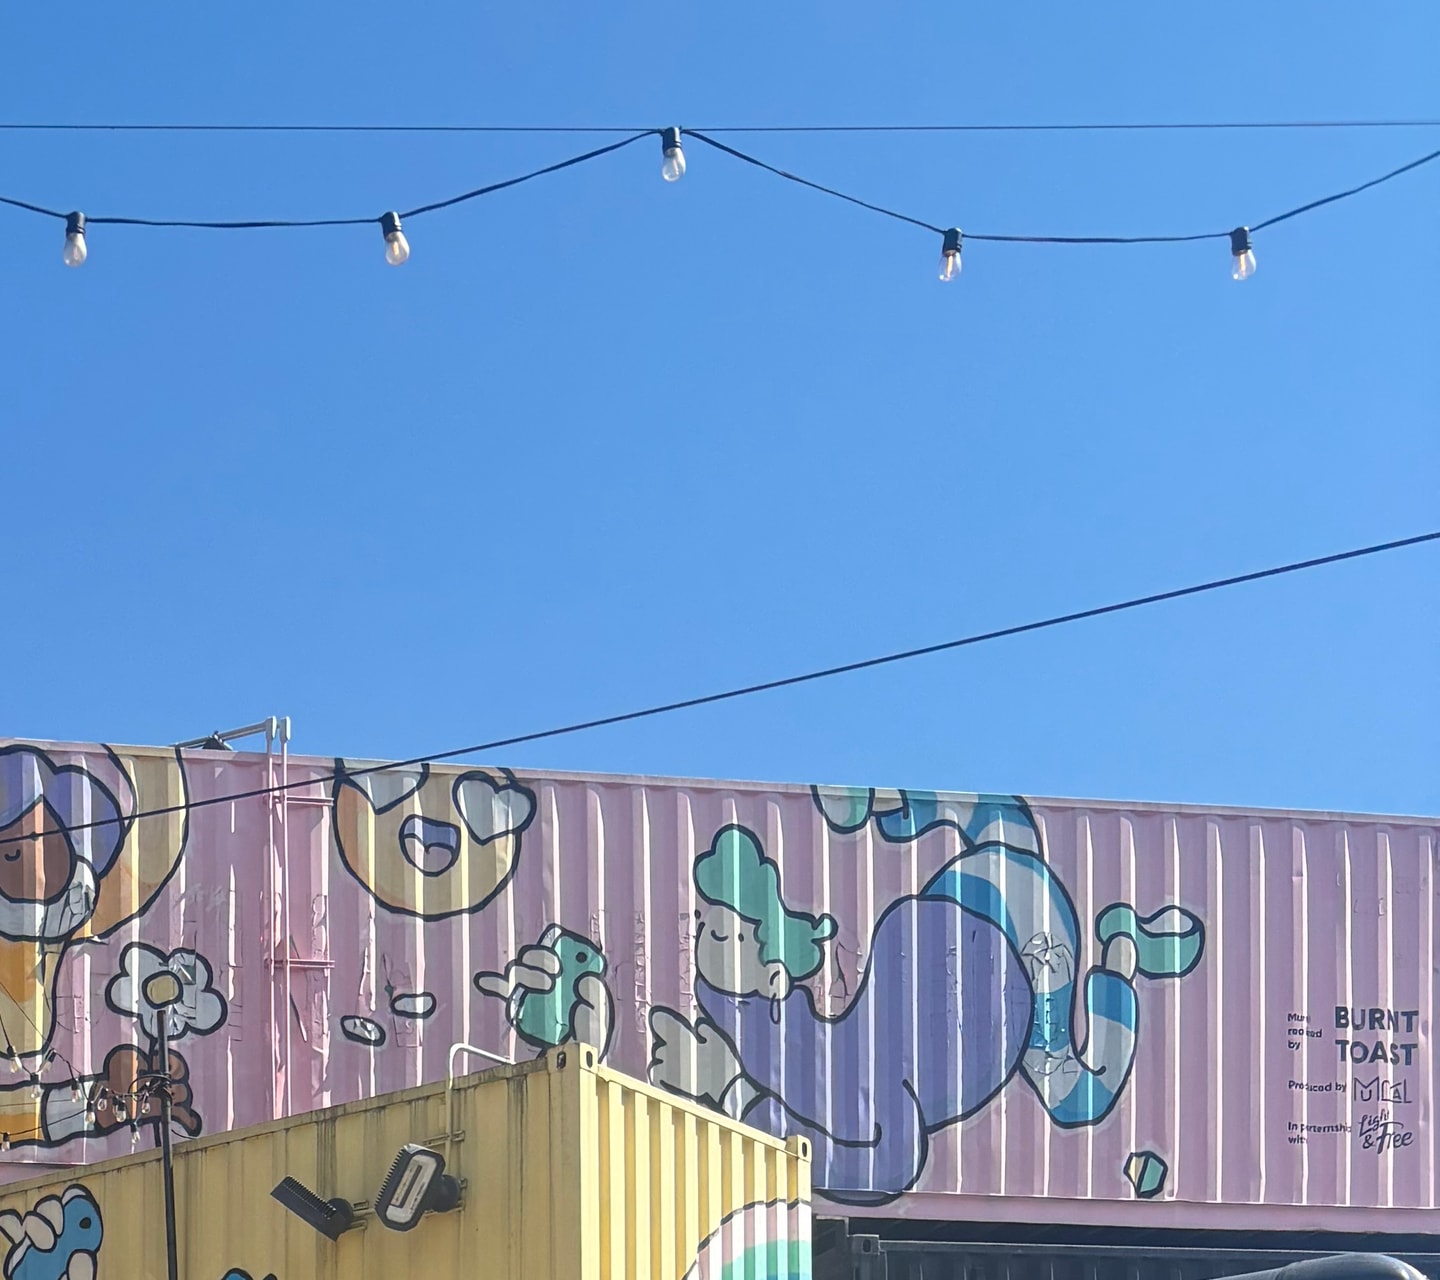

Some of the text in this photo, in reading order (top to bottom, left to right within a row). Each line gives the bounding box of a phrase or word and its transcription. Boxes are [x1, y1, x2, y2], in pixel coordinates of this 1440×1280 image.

[1335, 1006, 1419, 1033] BURNT
[1335, 1040, 1418, 1066] TOAST
[1288, 1135, 1308, 1144] wit
